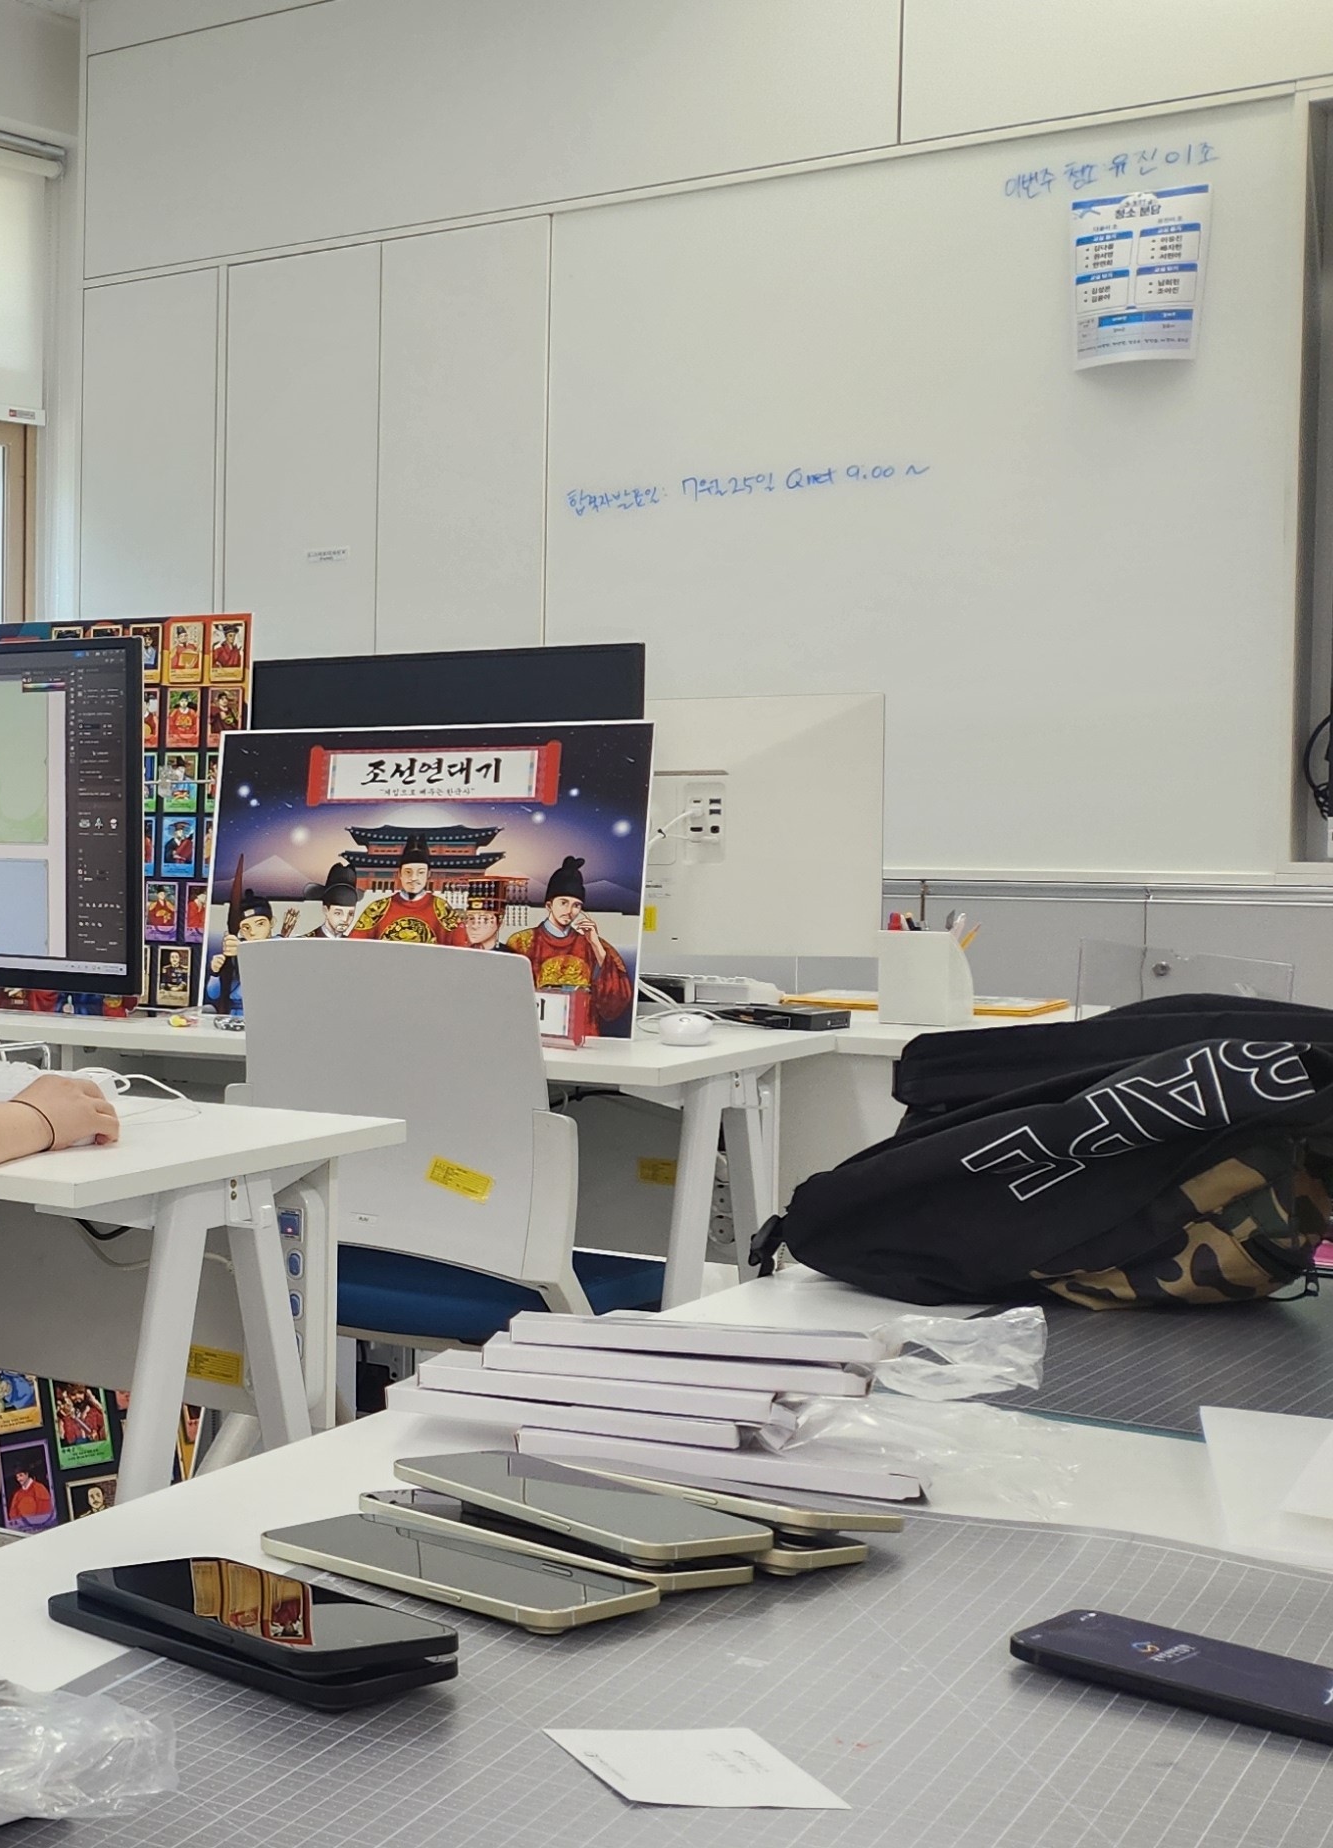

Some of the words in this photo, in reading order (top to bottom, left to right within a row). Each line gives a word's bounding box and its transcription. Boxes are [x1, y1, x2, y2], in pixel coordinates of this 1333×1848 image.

[1005, 167, 1055, 199] 이번주
[361, 757, 502, 785] 조선연대기
[960, 1039, 1317, 1202] BAPE
